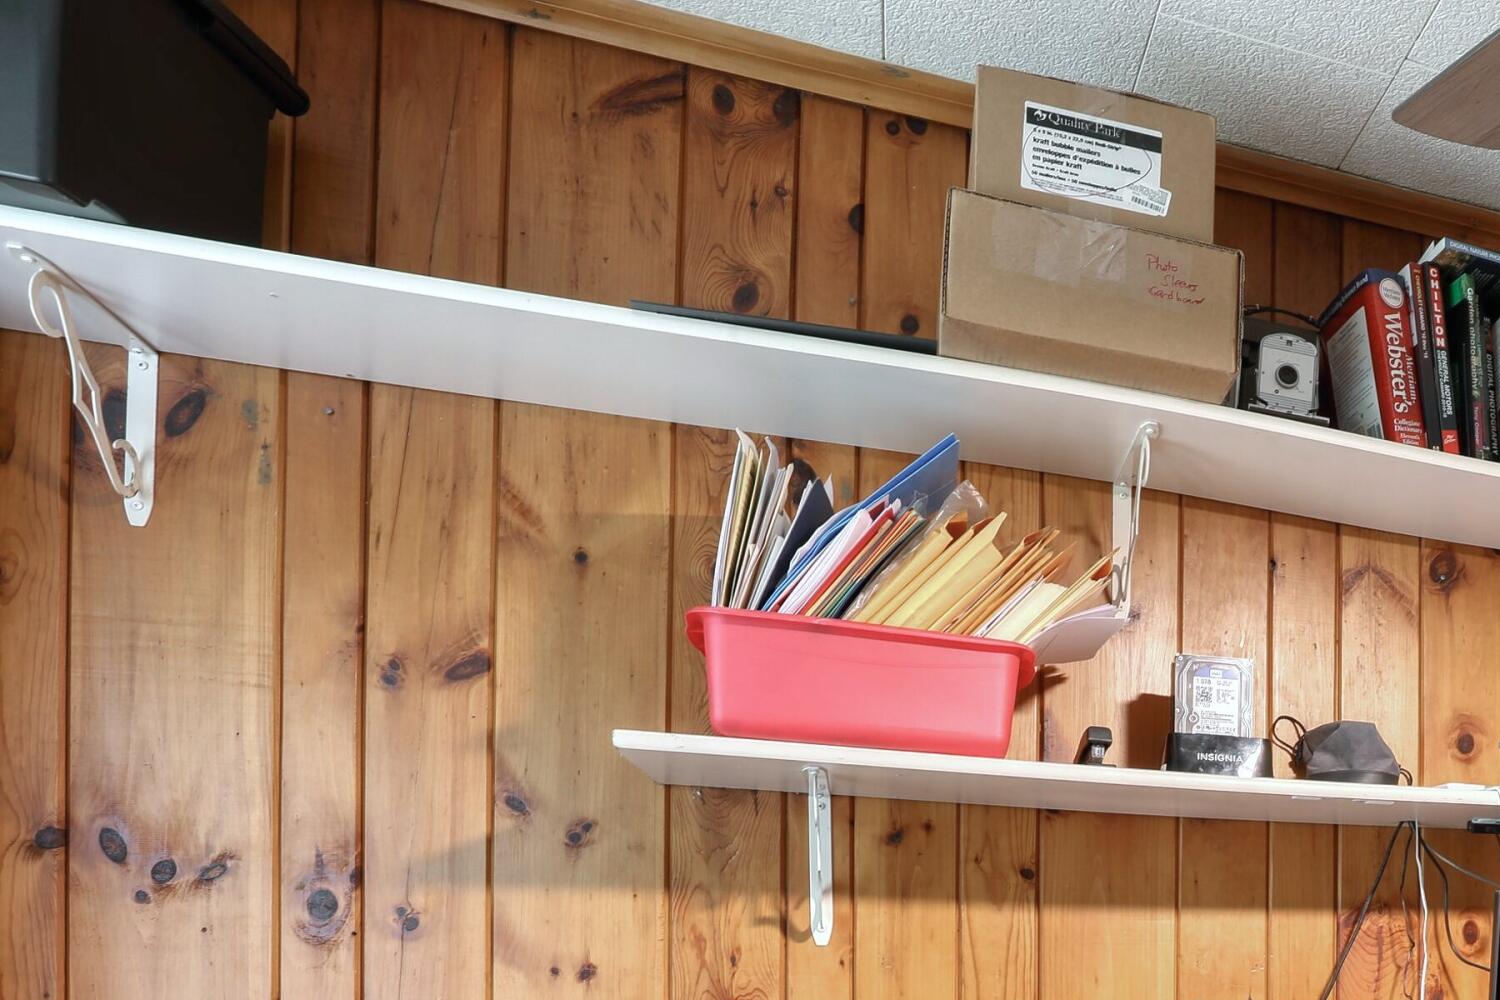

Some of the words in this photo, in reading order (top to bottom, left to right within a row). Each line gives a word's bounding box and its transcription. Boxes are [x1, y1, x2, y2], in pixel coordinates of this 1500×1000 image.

[1048, 112, 1091, 131] Quality
[1095, 122, 1121, 138] Park
[1033, 137, 1049, 146] kraft
[1051, 140, 1074, 151] bubble
[1076, 145, 1101, 157] mailers
[1033, 146, 1070, 160] enveloppes
[1121, 164, 1141, 175] bulles
[1043, 156, 1063, 167] papier
[1066, 159, 1082, 170] kraft
[1146, 253, 1178, 272] Photo
[1417, 306, 1426, 331] CAMARO
[1429, 267, 1445, 347] CHILTON
[1466, 287, 1474, 324] Garden
[1384, 311, 1409, 413] Webster's
[1440, 350, 1449, 383] GENERAL
[1469, 326, 1481, 390] photography
[1486, 353, 1494, 387] DIGITAL
[1443, 383, 1453, 415] MOTORS
[1393, 418, 1422, 428] Collegiate
[1394, 424, 1423, 435] Dictionary
[1488, 389, 1500, 454] PHOTOGRAPHY
[1196, 750, 1243, 763] INSIGNIA
